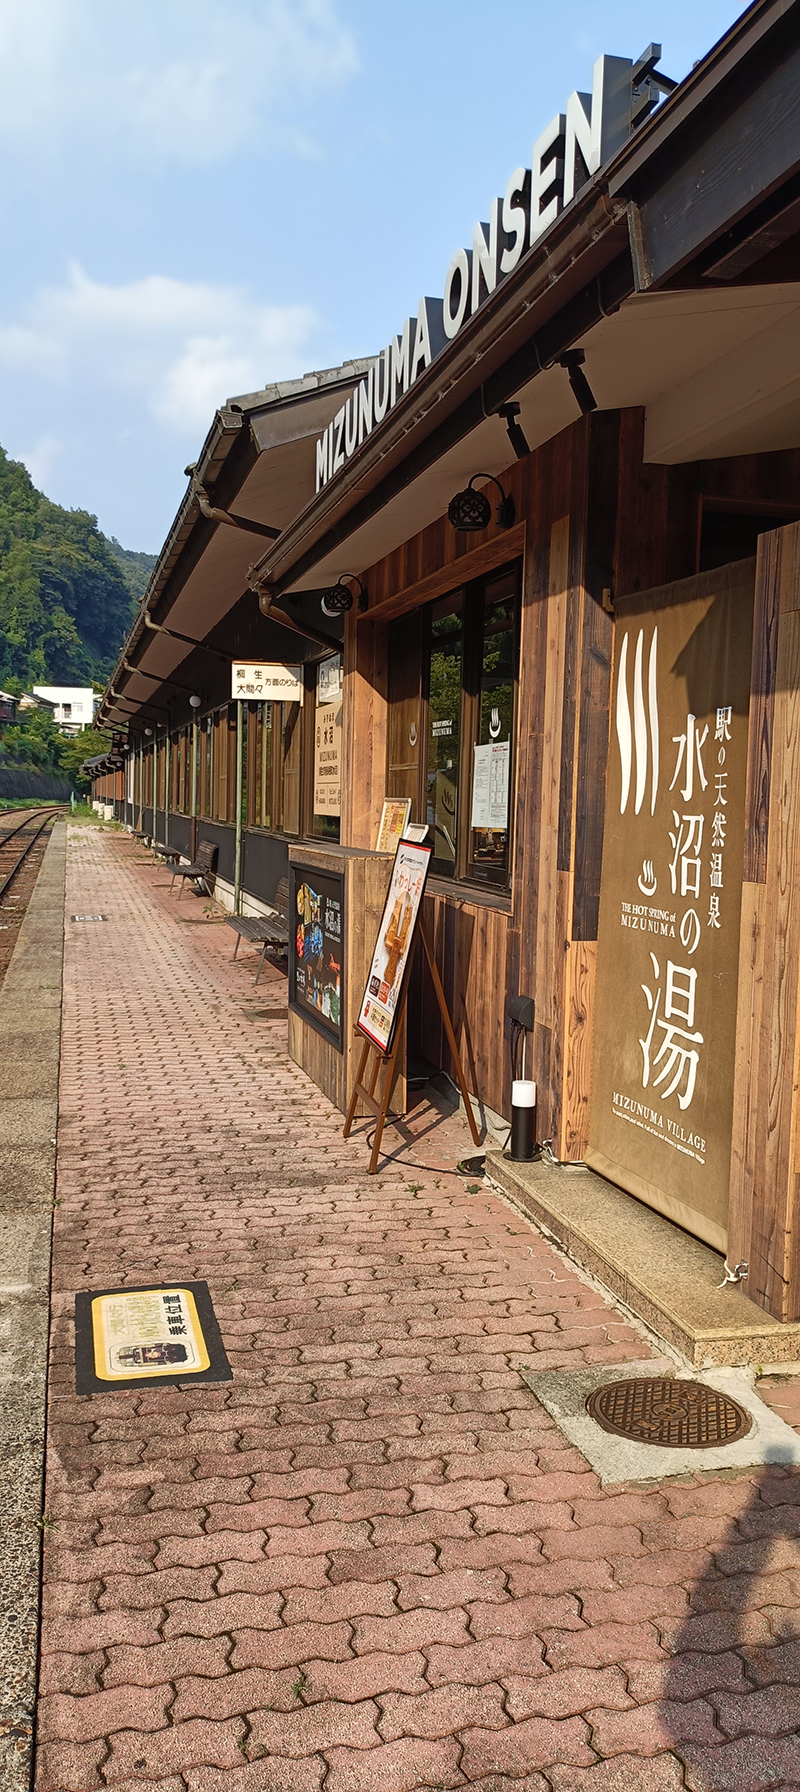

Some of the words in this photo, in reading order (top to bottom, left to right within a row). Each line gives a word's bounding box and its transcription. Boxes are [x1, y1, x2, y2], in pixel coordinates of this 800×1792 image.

[315, 297, 435, 494] MIZUNUMA
[442, 54, 607, 340] ONSEN
[236, 684, 264, 695] 大間々
[264, 678, 300, 688] 方面のりば
[706, 705, 733, 929] 駅の天然温泉
[620, 901, 632, 913] THE
[632, 904, 648, 916] HOT
[648, 907, 670, 921] SPRING
[669, 911, 677, 923] of
[620, 913, 676, 938] MIZUNUMA
[638, 713, 710, 1111] 水沼の湯
[612, 1091, 664, 1128] MIZUNUMA
[666, 1118, 707, 1153] VILLAGE
[162, 1294, 188, 1336] 乗車位置
